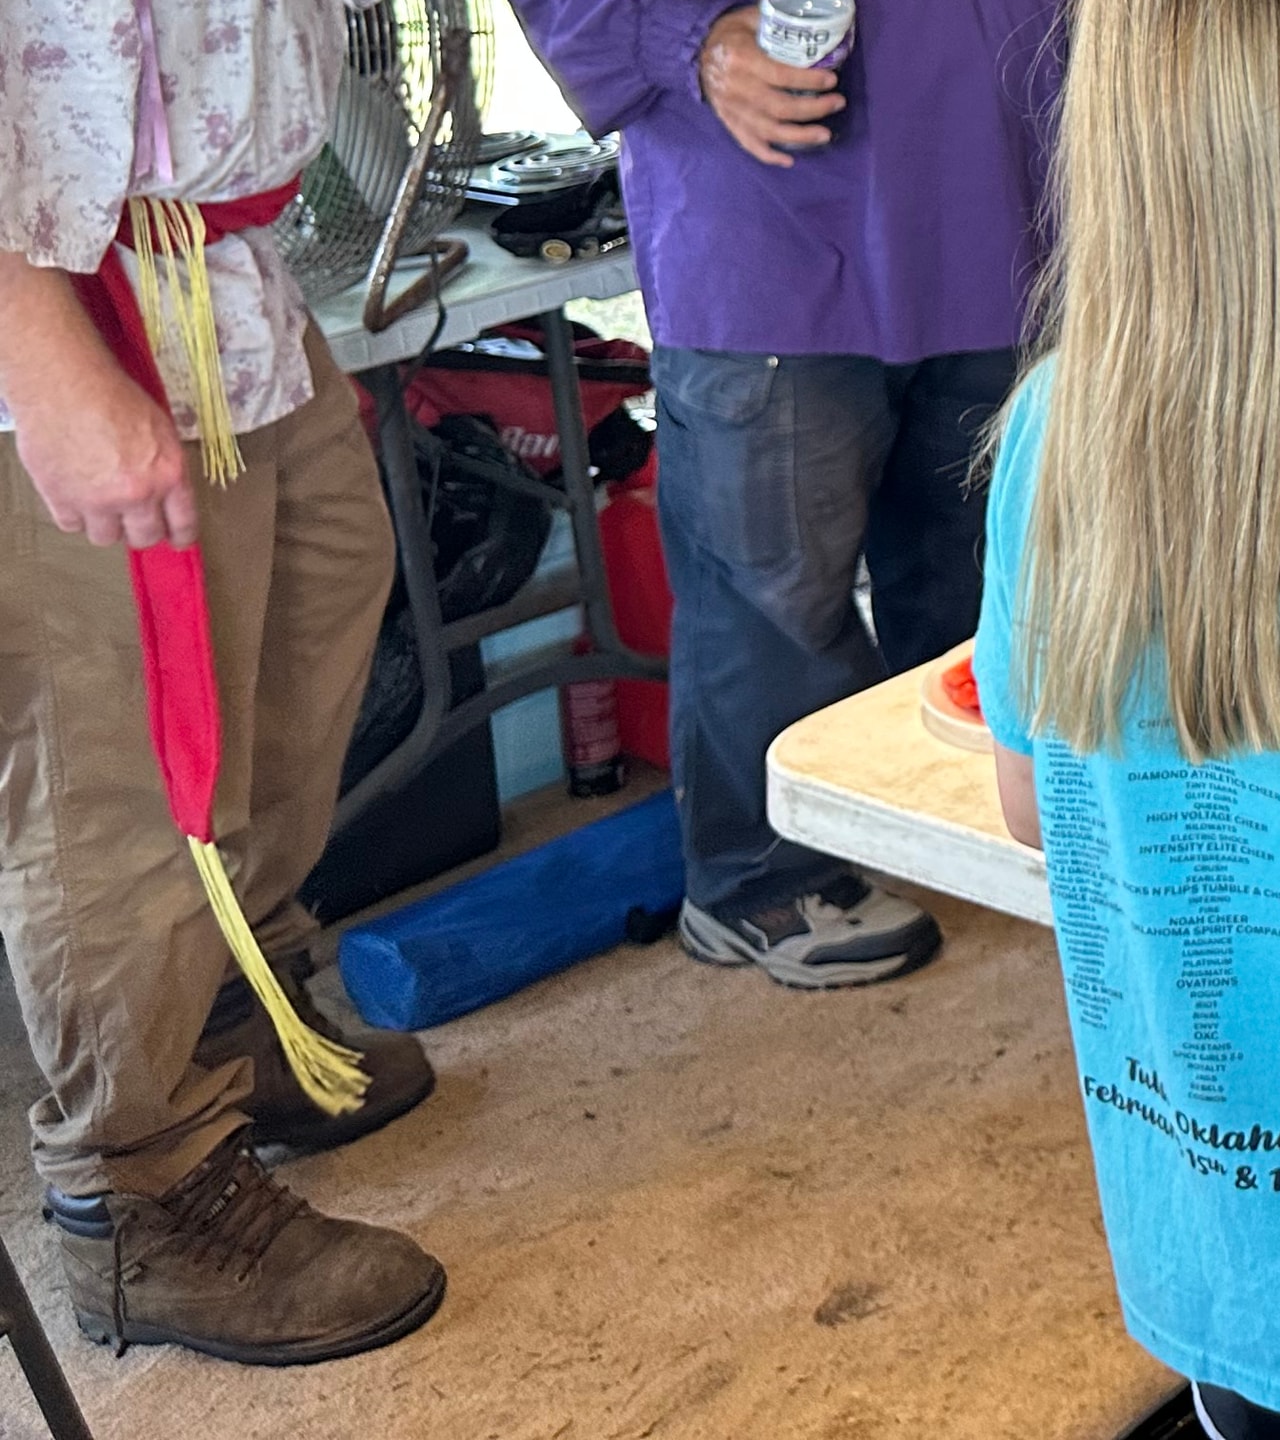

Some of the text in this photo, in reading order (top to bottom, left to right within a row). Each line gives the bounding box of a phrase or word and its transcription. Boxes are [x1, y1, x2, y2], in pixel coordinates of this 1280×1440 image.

[1127, 769, 1280, 802] DIAMOND ATHLETICS CHEER
[1146, 810, 1268, 833] HIGH VOLTAGE CHEER
[1139, 841, 1275, 862] INTENSITY ELITE CHEER
[1151, 884, 1162, 897] N
[1163, 884, 1200, 897] FLIPS
[1202, 883, 1249, 895] TUMBLE
[1168, 913, 1249, 927] NOAH CHEER
[1192, 923, 1233, 936] SPIRIT
[1175, 975, 1239, 990] OVATIONS
[1235, 1166, 1259, 1190] &
